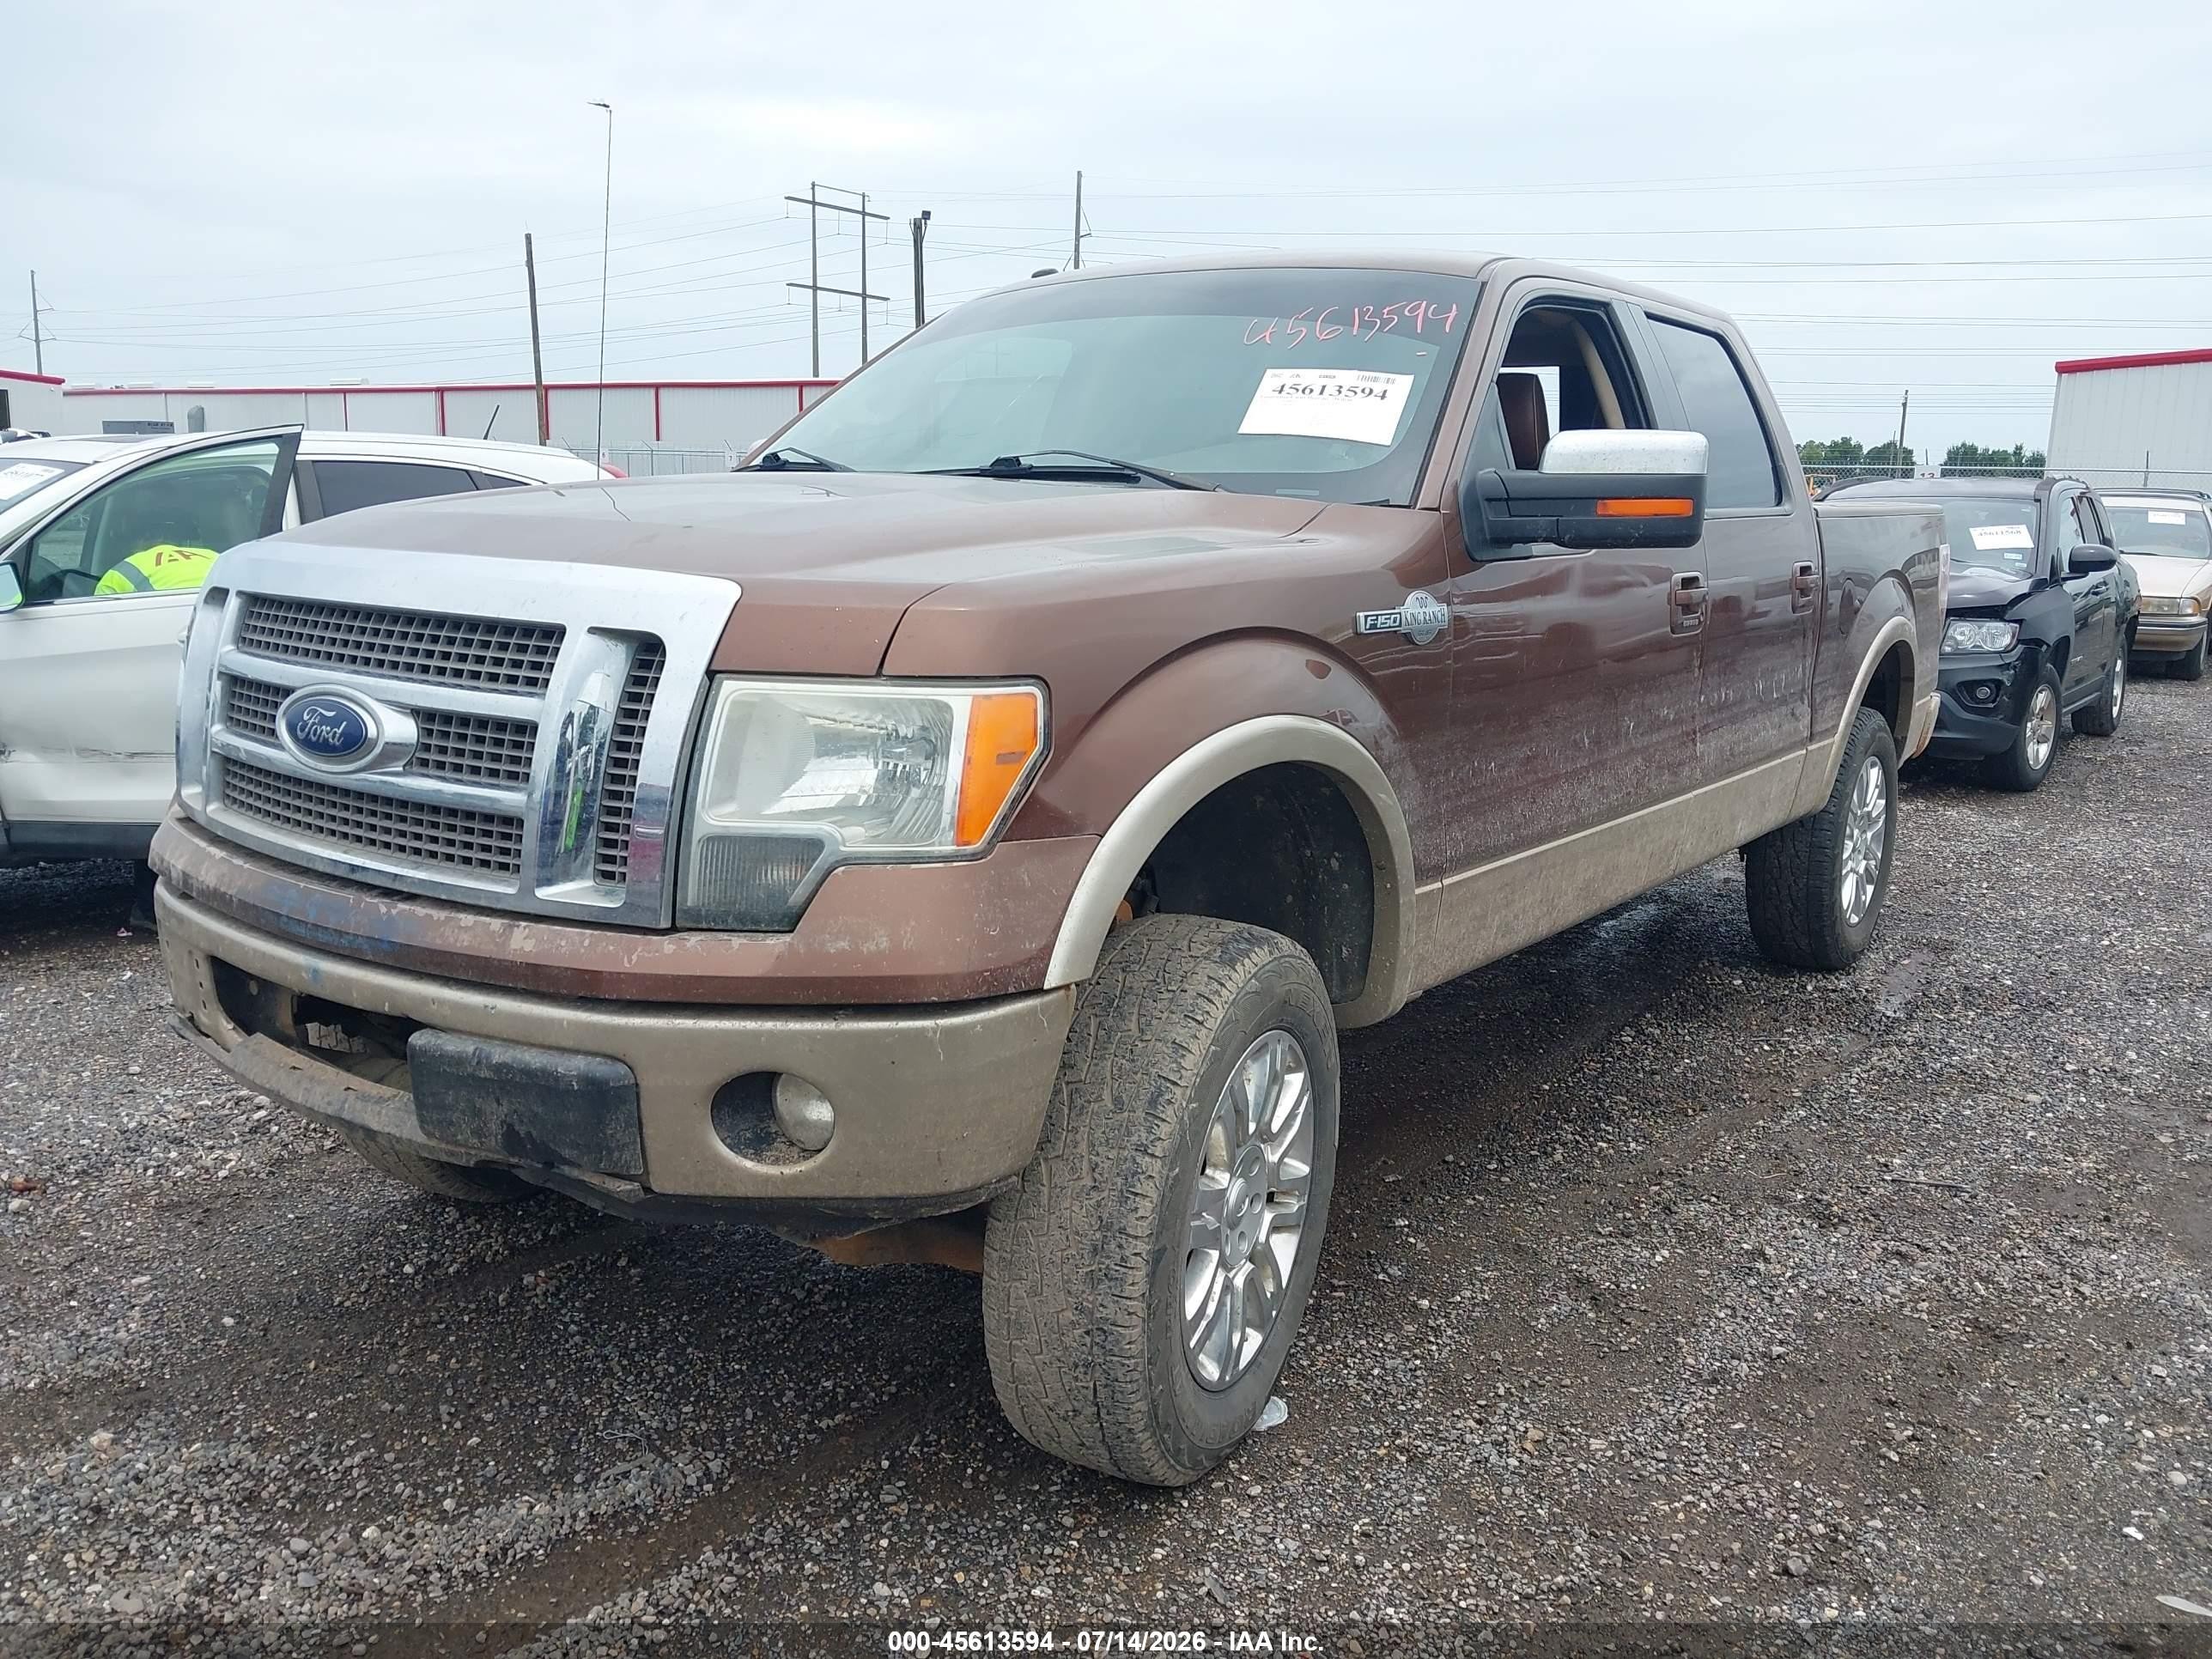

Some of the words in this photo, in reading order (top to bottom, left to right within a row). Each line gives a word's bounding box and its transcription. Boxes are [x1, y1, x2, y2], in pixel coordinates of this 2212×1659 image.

[1243, 301, 1458, 349] 45613594
[1272, 383, 1389, 401] 45613594
[1366, 615, 1401, 629] F-150
[1404, 611, 1422, 627] KING
[1423, 607, 1446, 625] RANCH
[296, 706, 347, 746] Ford
